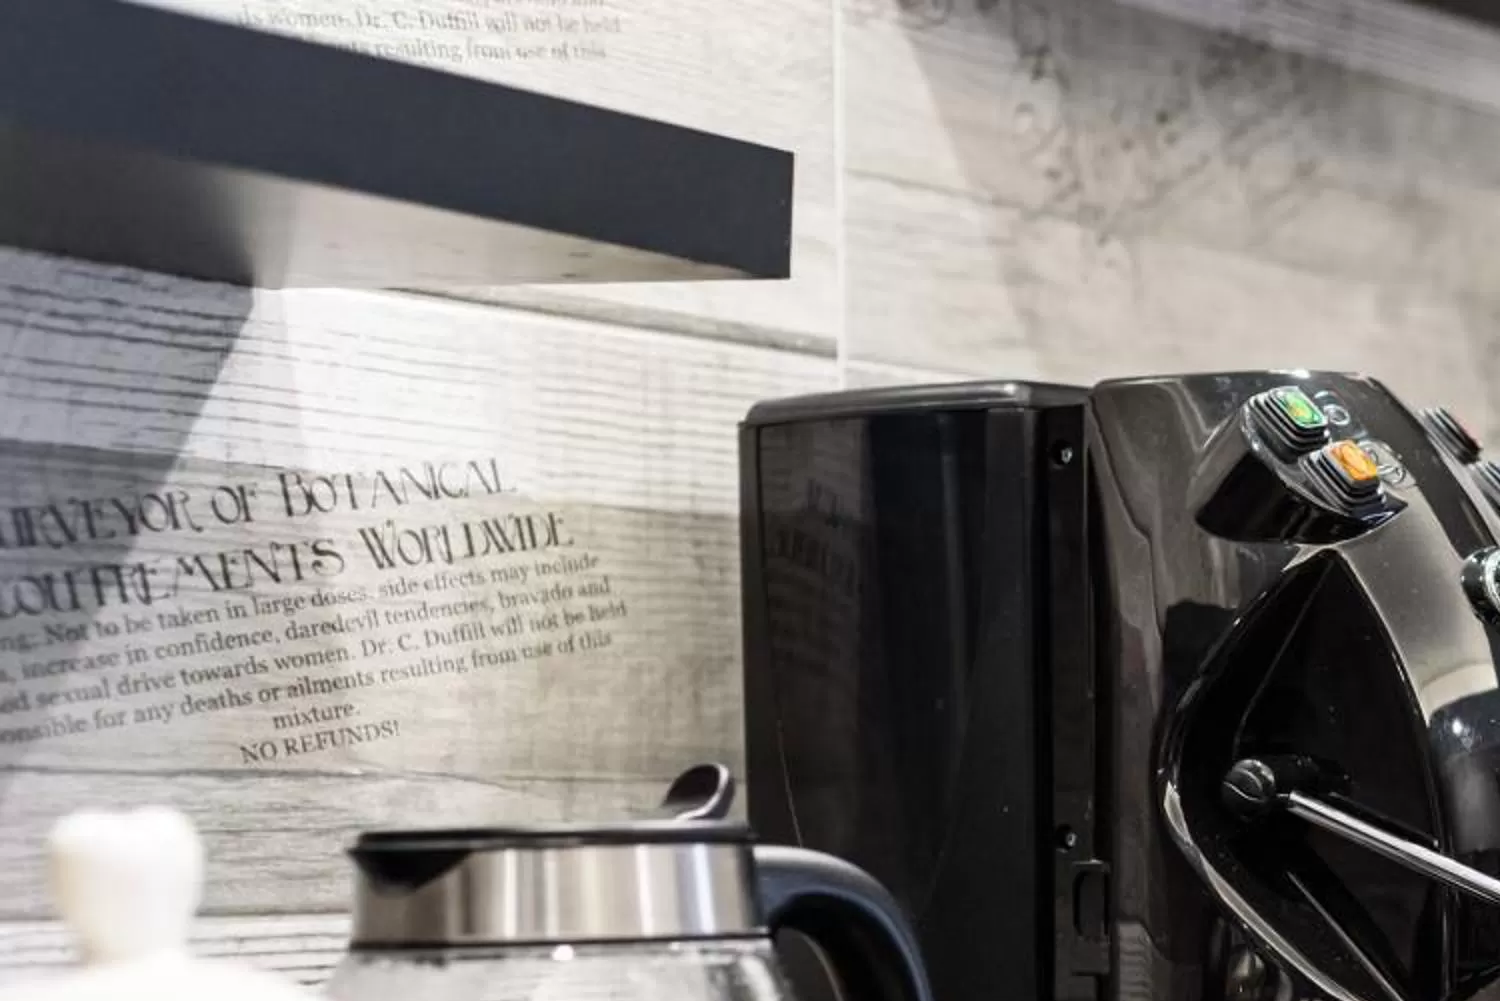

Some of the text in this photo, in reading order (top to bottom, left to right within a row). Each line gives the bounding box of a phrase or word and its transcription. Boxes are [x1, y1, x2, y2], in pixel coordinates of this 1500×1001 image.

[211, 482, 257, 524] OF
[94, 619, 120, 637] to
[122, 614, 152, 634] be
[156, 604, 221, 630] taken
[225, 600, 248, 619] in
[252, 594, 306, 617] large
[378, 576, 419, 599] side
[423, 569, 487, 592] effects
[489, 562, 530, 585] may
[534, 551, 599, 577] include
[124, 643, 150, 666] in
[284, 608, 381, 643] daredevil
[497, 582, 574, 609] bravado
[577, 575, 611, 599] and
[35, 676, 112, 706] sexual
[116, 671, 178, 697] drive
[180, 654, 270, 688] towards
[361, 636, 395, 658] Dr.
[397, 632, 419, 652] C.
[423, 620, 487, 648] Duffill
[489, 612, 525, 637] will
[528, 611, 560, 632] not
[562, 607, 585, 626] be
[587, 600, 629, 623] held
[92, 708, 129, 730] for
[132, 703, 176, 725] any
[179, 687, 254, 718] deaths
[257, 685, 284, 703] or
[286, 670, 377, 699] ailments
[380, 656, 468, 683] resulting
[471, 648, 518, 671] from
[521, 642, 554, 659] use
[556, 633, 577, 654] of
[578, 629, 614, 651] this
[238, 719, 401, 766] NO REFUNDS!
[271, 702, 362, 731] mixture.
